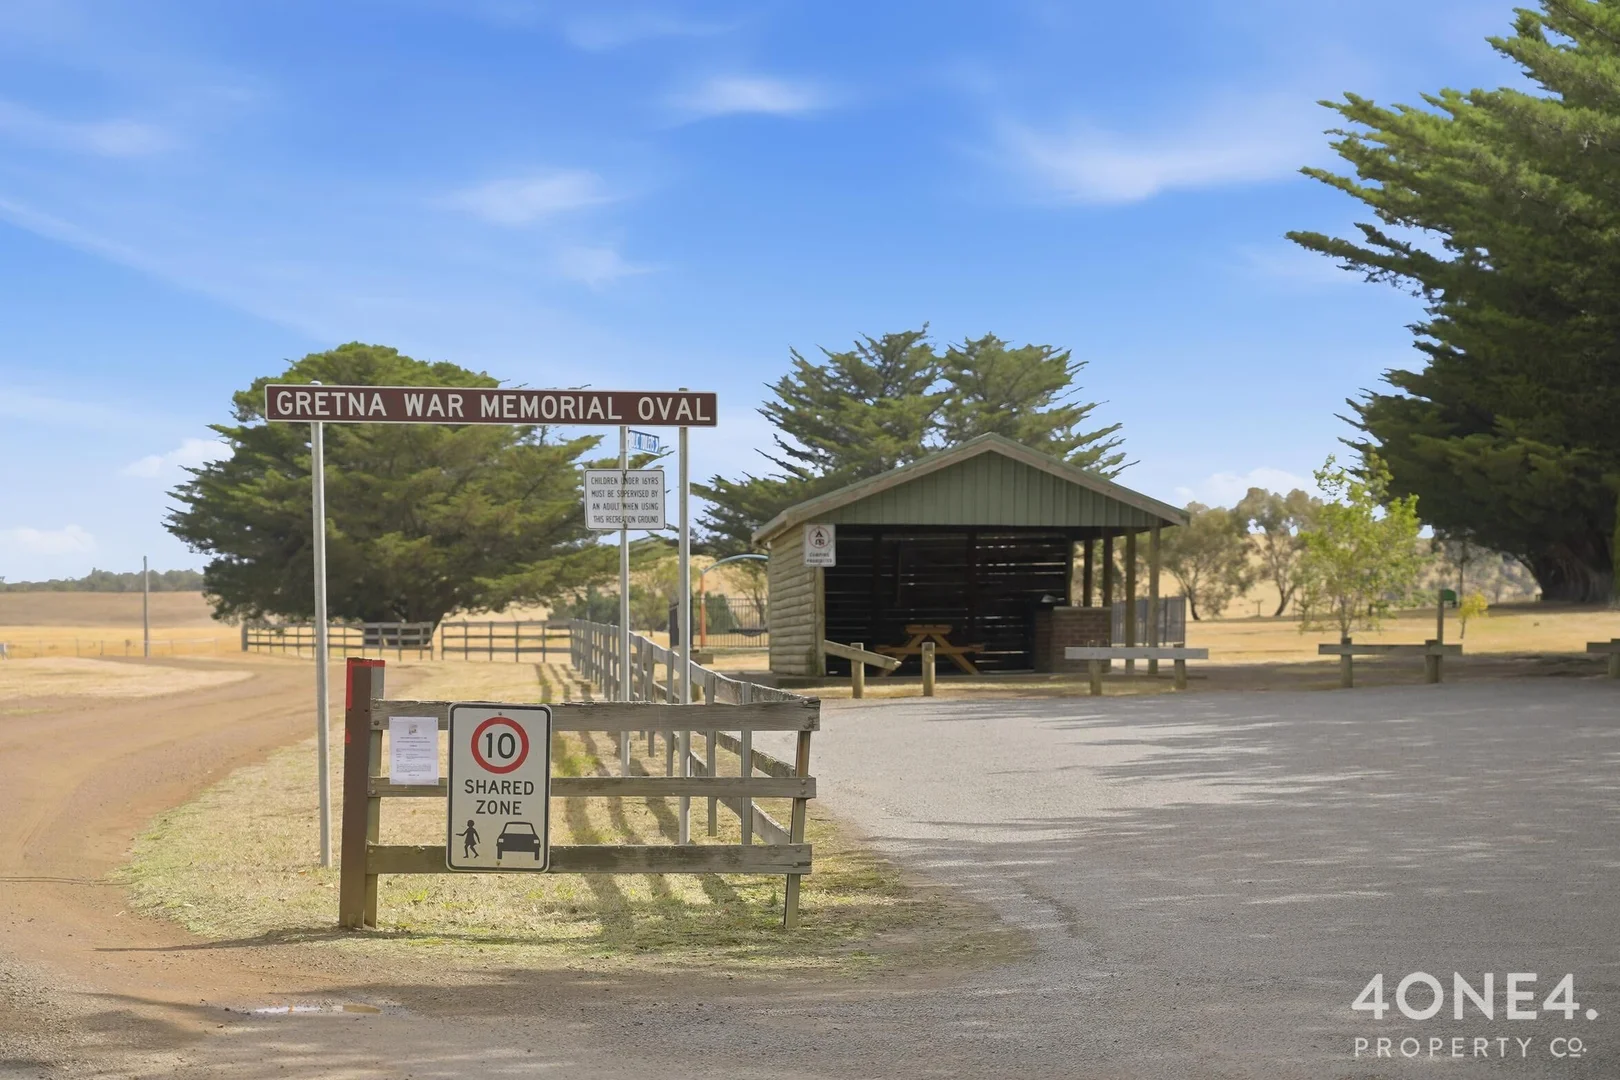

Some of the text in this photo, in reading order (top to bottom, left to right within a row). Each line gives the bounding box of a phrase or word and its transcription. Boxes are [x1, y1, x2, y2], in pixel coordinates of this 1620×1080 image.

[276, 390, 711, 421] GRETNA WAR MEMORIAL OVAL
[590, 477, 619, 485] CHILDREN
[620, 477, 640, 485] UNDER
[591, 489, 659, 498] MUST BE SUPERVISED BY
[592, 502, 659, 511] AN ADULT WHEN USING
[593, 515, 659, 523] THIS RECREATION GROUND
[485, 732, 516, 760] 10
[464, 779, 535, 796] SHARED
[475, 800, 523, 816] ZONE
